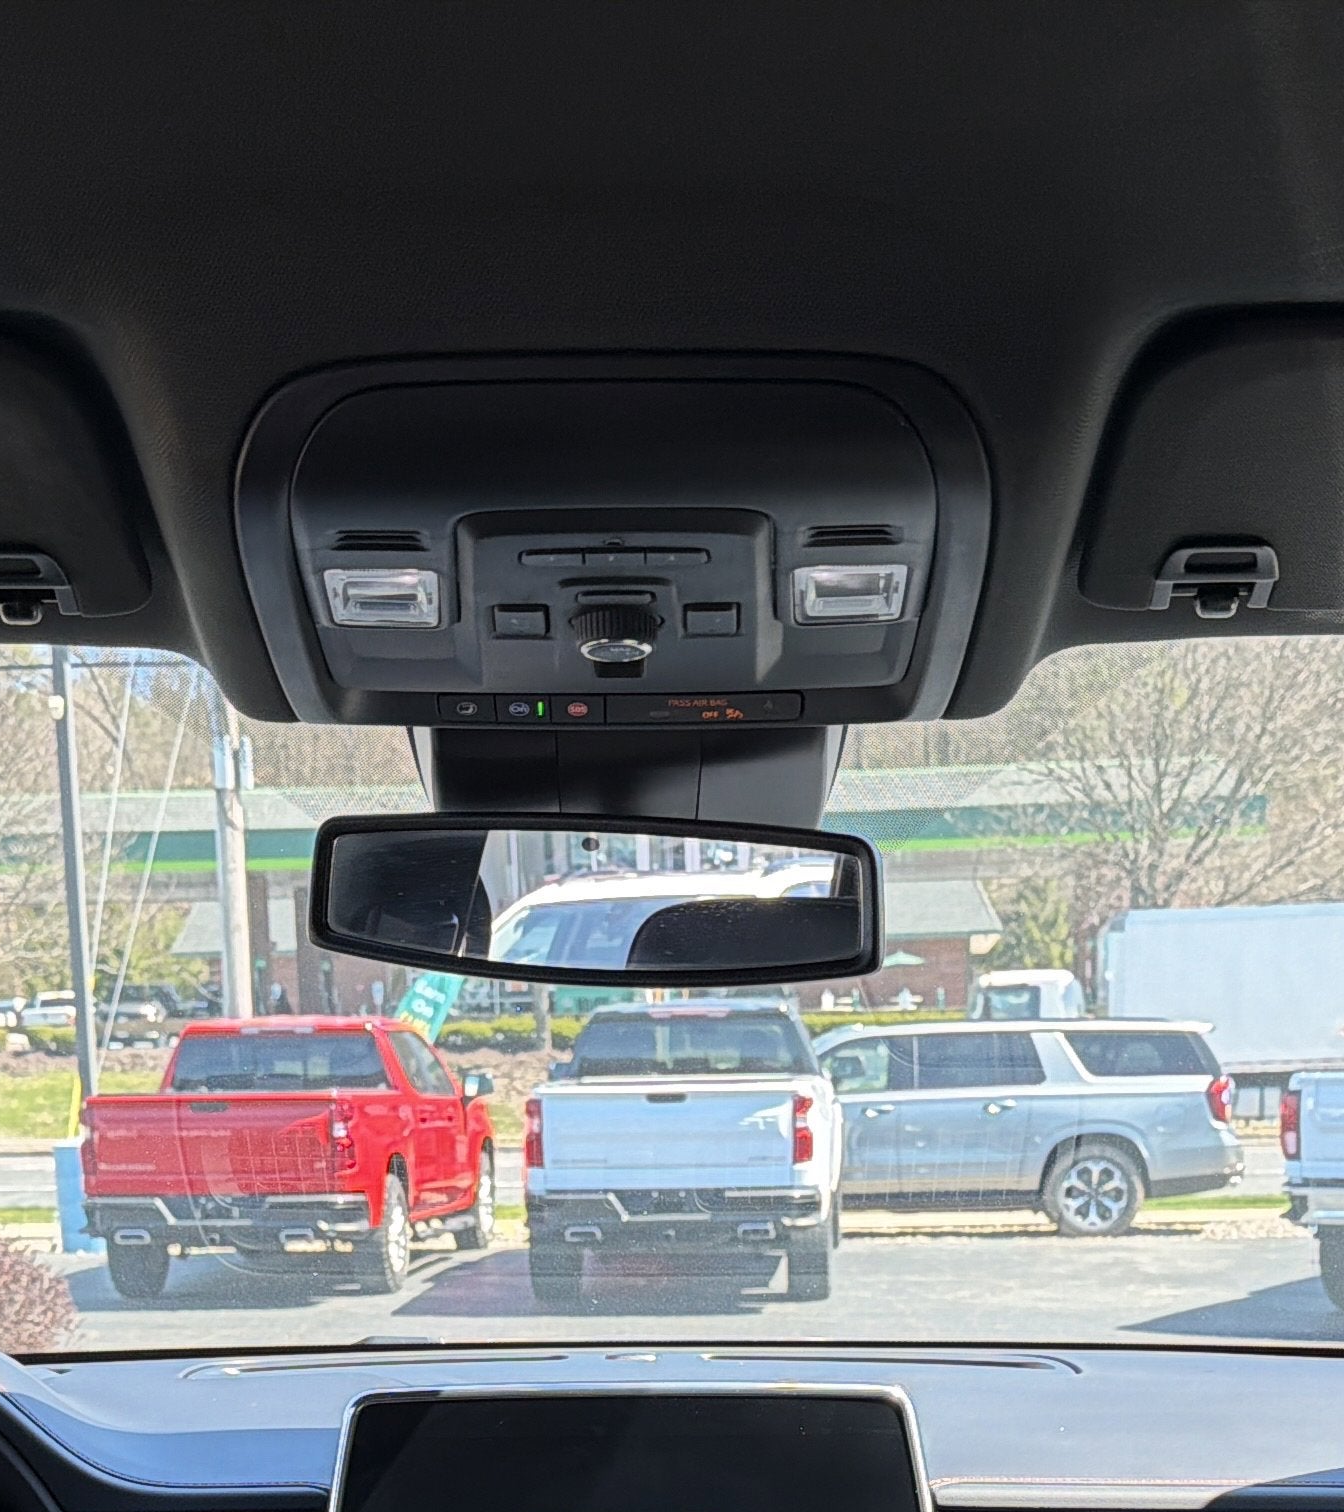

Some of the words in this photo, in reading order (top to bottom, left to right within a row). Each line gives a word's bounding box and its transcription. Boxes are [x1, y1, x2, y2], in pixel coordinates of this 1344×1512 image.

[668, 699, 693, 707] PASS
[694, 699, 708, 707] AIR
[569, 705, 587, 713] SOS
[702, 710, 719, 719] OFF
